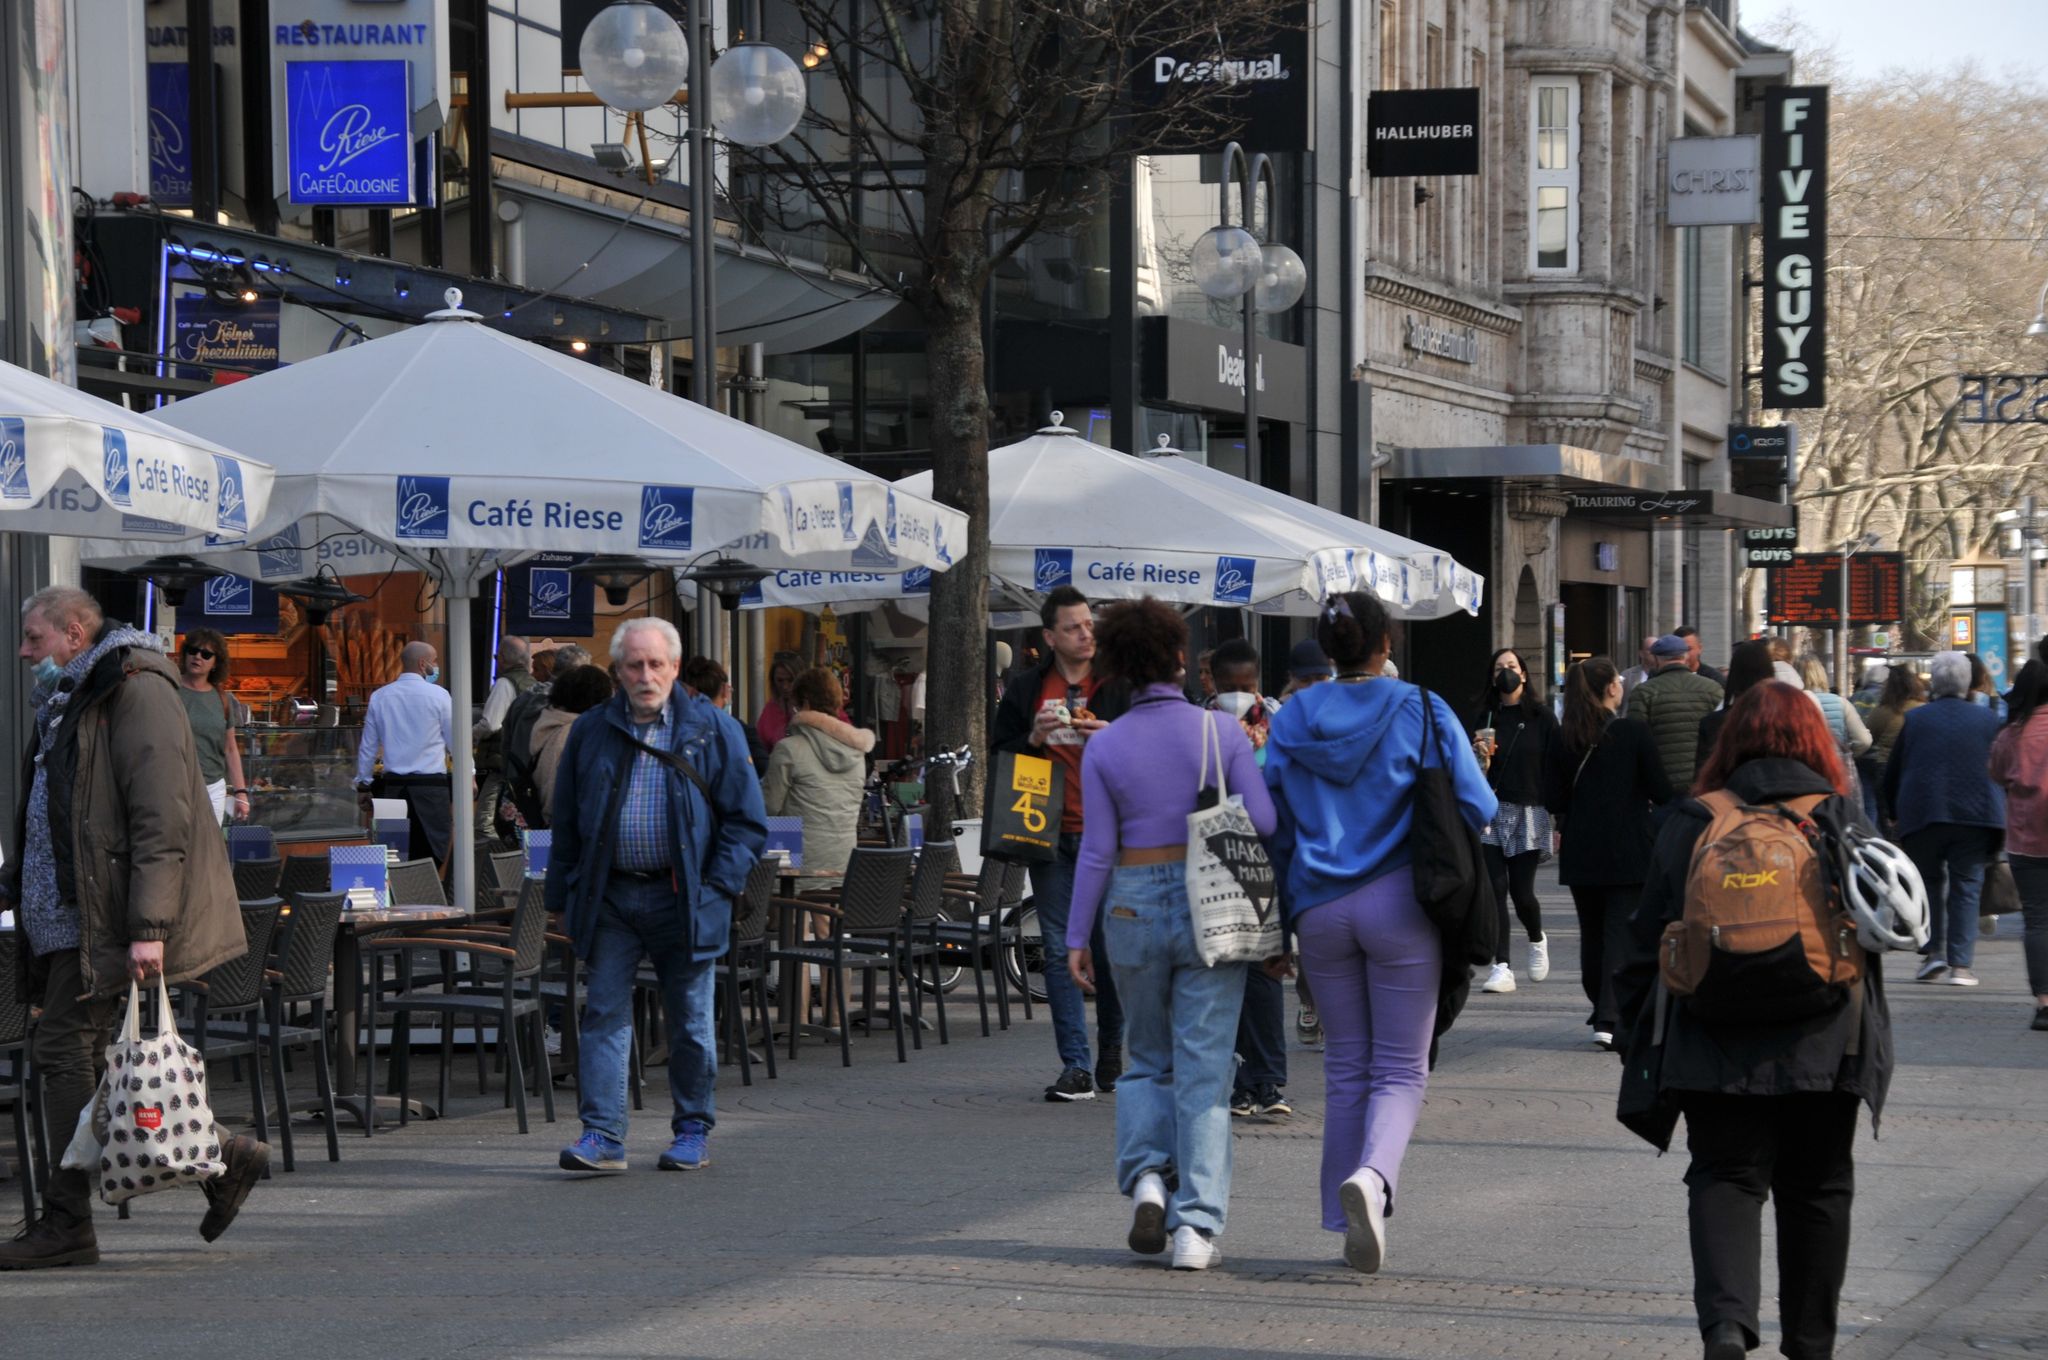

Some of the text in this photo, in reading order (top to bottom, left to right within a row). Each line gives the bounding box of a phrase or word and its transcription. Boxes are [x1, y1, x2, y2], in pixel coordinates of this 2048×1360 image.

[276, 24, 426, 45] RESTAURANT
[1376, 124, 1473, 139] HALLHUBER
[1778, 98, 1813, 239] FIVE
[1671, 168, 1754, 194] CHRIST
[1776, 253, 1813, 396] GUYS
[136, 457, 209, 504] Café Riese
[1574, 495, 1636, 508] TRAURING
[467, 498, 623, 531] Café Riese
[1747, 527, 1797, 540] GUYS
[1751, 550, 1792, 562] GUYS
[1088, 562, 1201, 584] Café Riese
